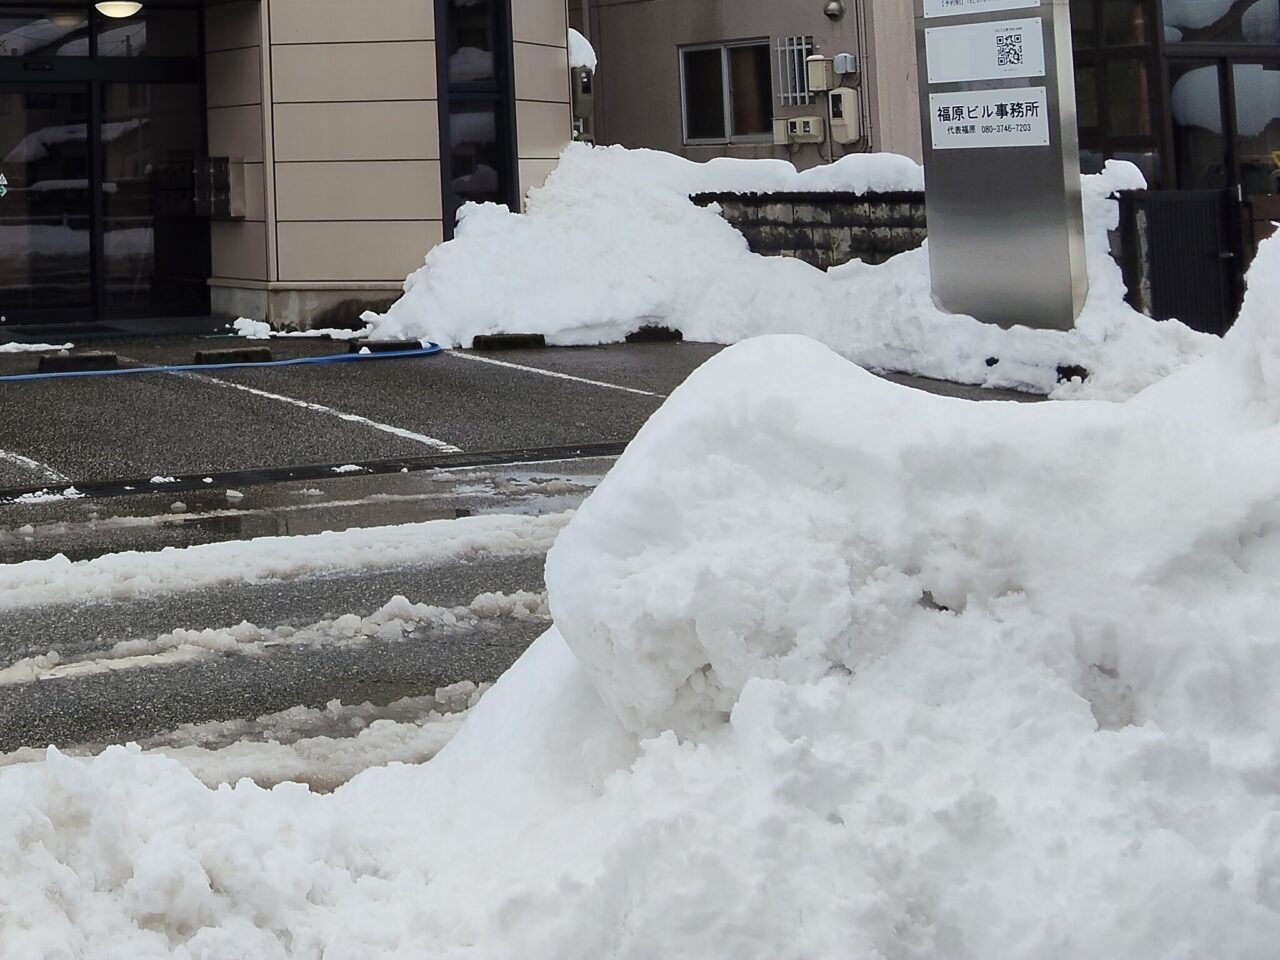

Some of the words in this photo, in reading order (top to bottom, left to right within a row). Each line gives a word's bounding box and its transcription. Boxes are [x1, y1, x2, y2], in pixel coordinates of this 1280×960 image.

[937, 101, 1039, 122] 福原ビル事務所
[981, 123, 1031, 134] 080-3746-7203
